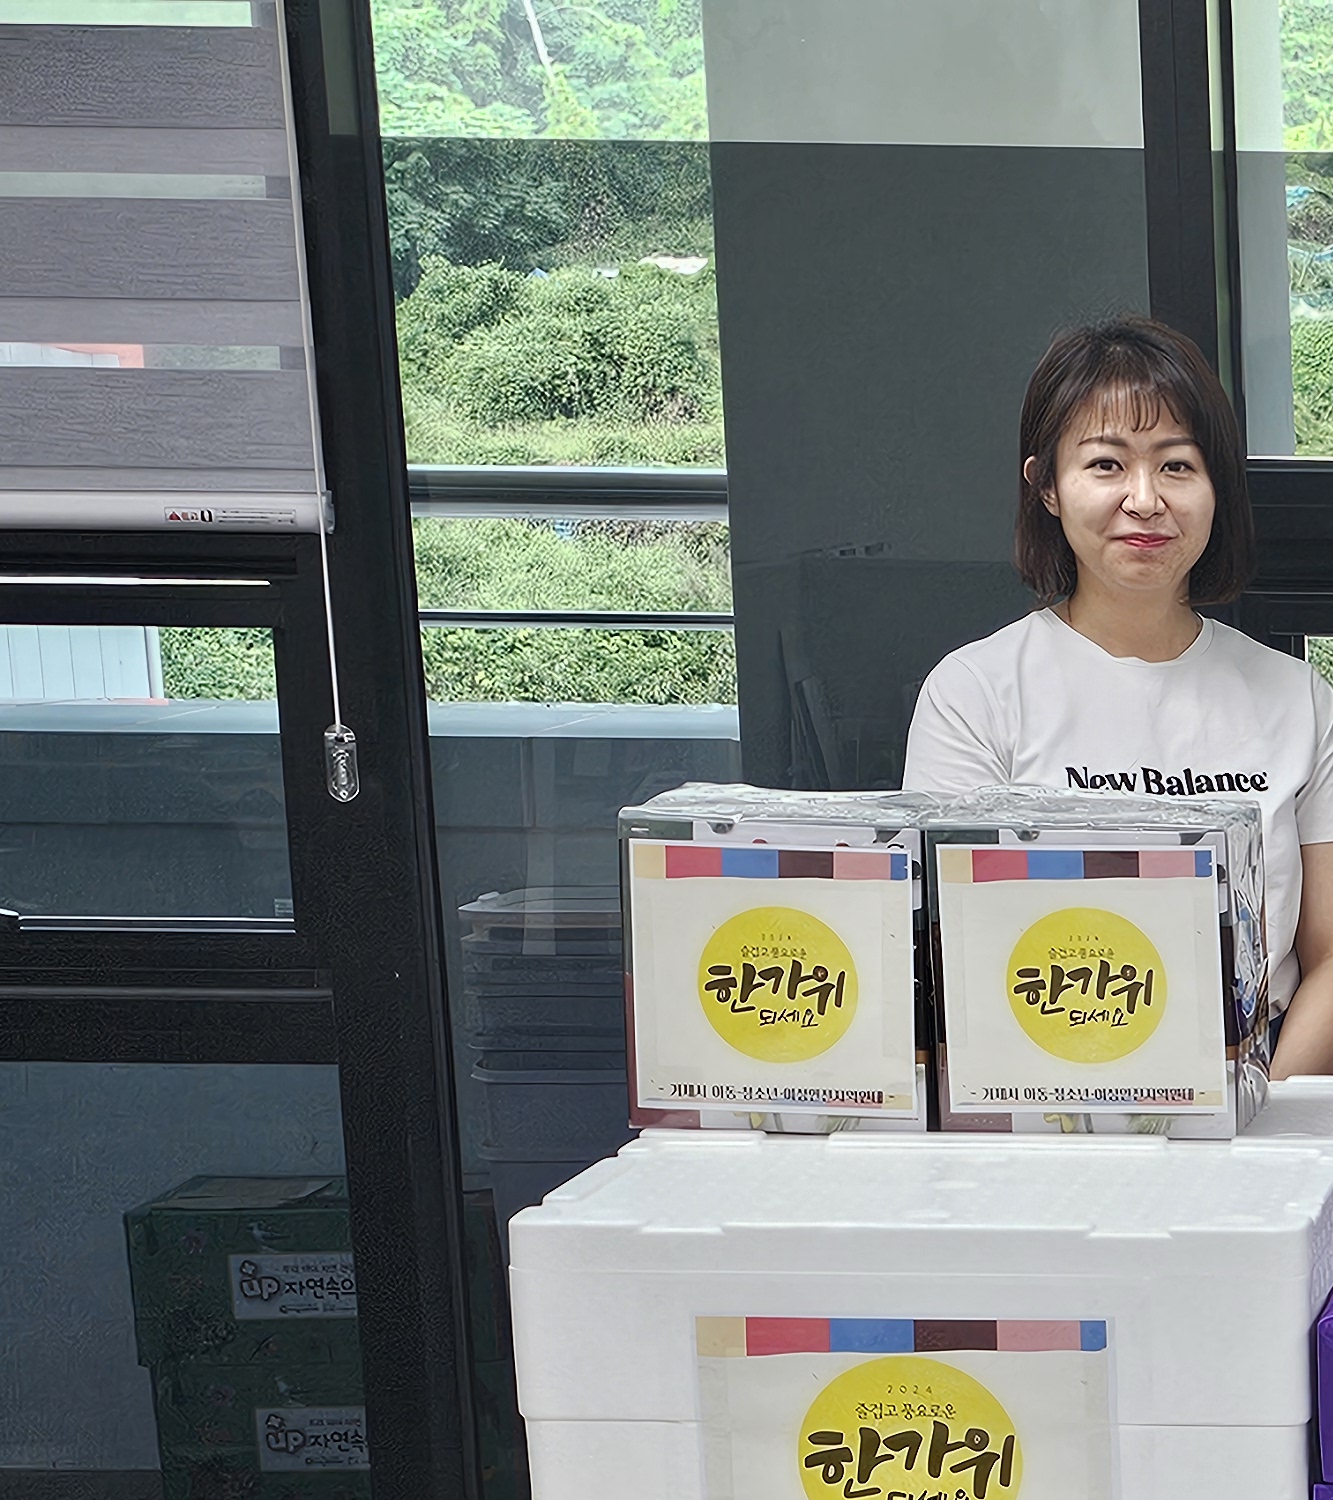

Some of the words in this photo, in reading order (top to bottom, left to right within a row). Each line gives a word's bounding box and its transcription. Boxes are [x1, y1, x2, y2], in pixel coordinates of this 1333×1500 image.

[1065, 766, 1137, 791] New
[1141, 766, 1268, 796] Balance
[704, 959, 846, 1016] 한가위
[1014, 959, 1153, 1015] 한가위
[759, 1009, 818, 1028] 되세요
[1068, 1008, 1129, 1028] 되세요
[887, 1384, 933, 1394] 2024
[804, 1420, 1016, 1499] 한가위
